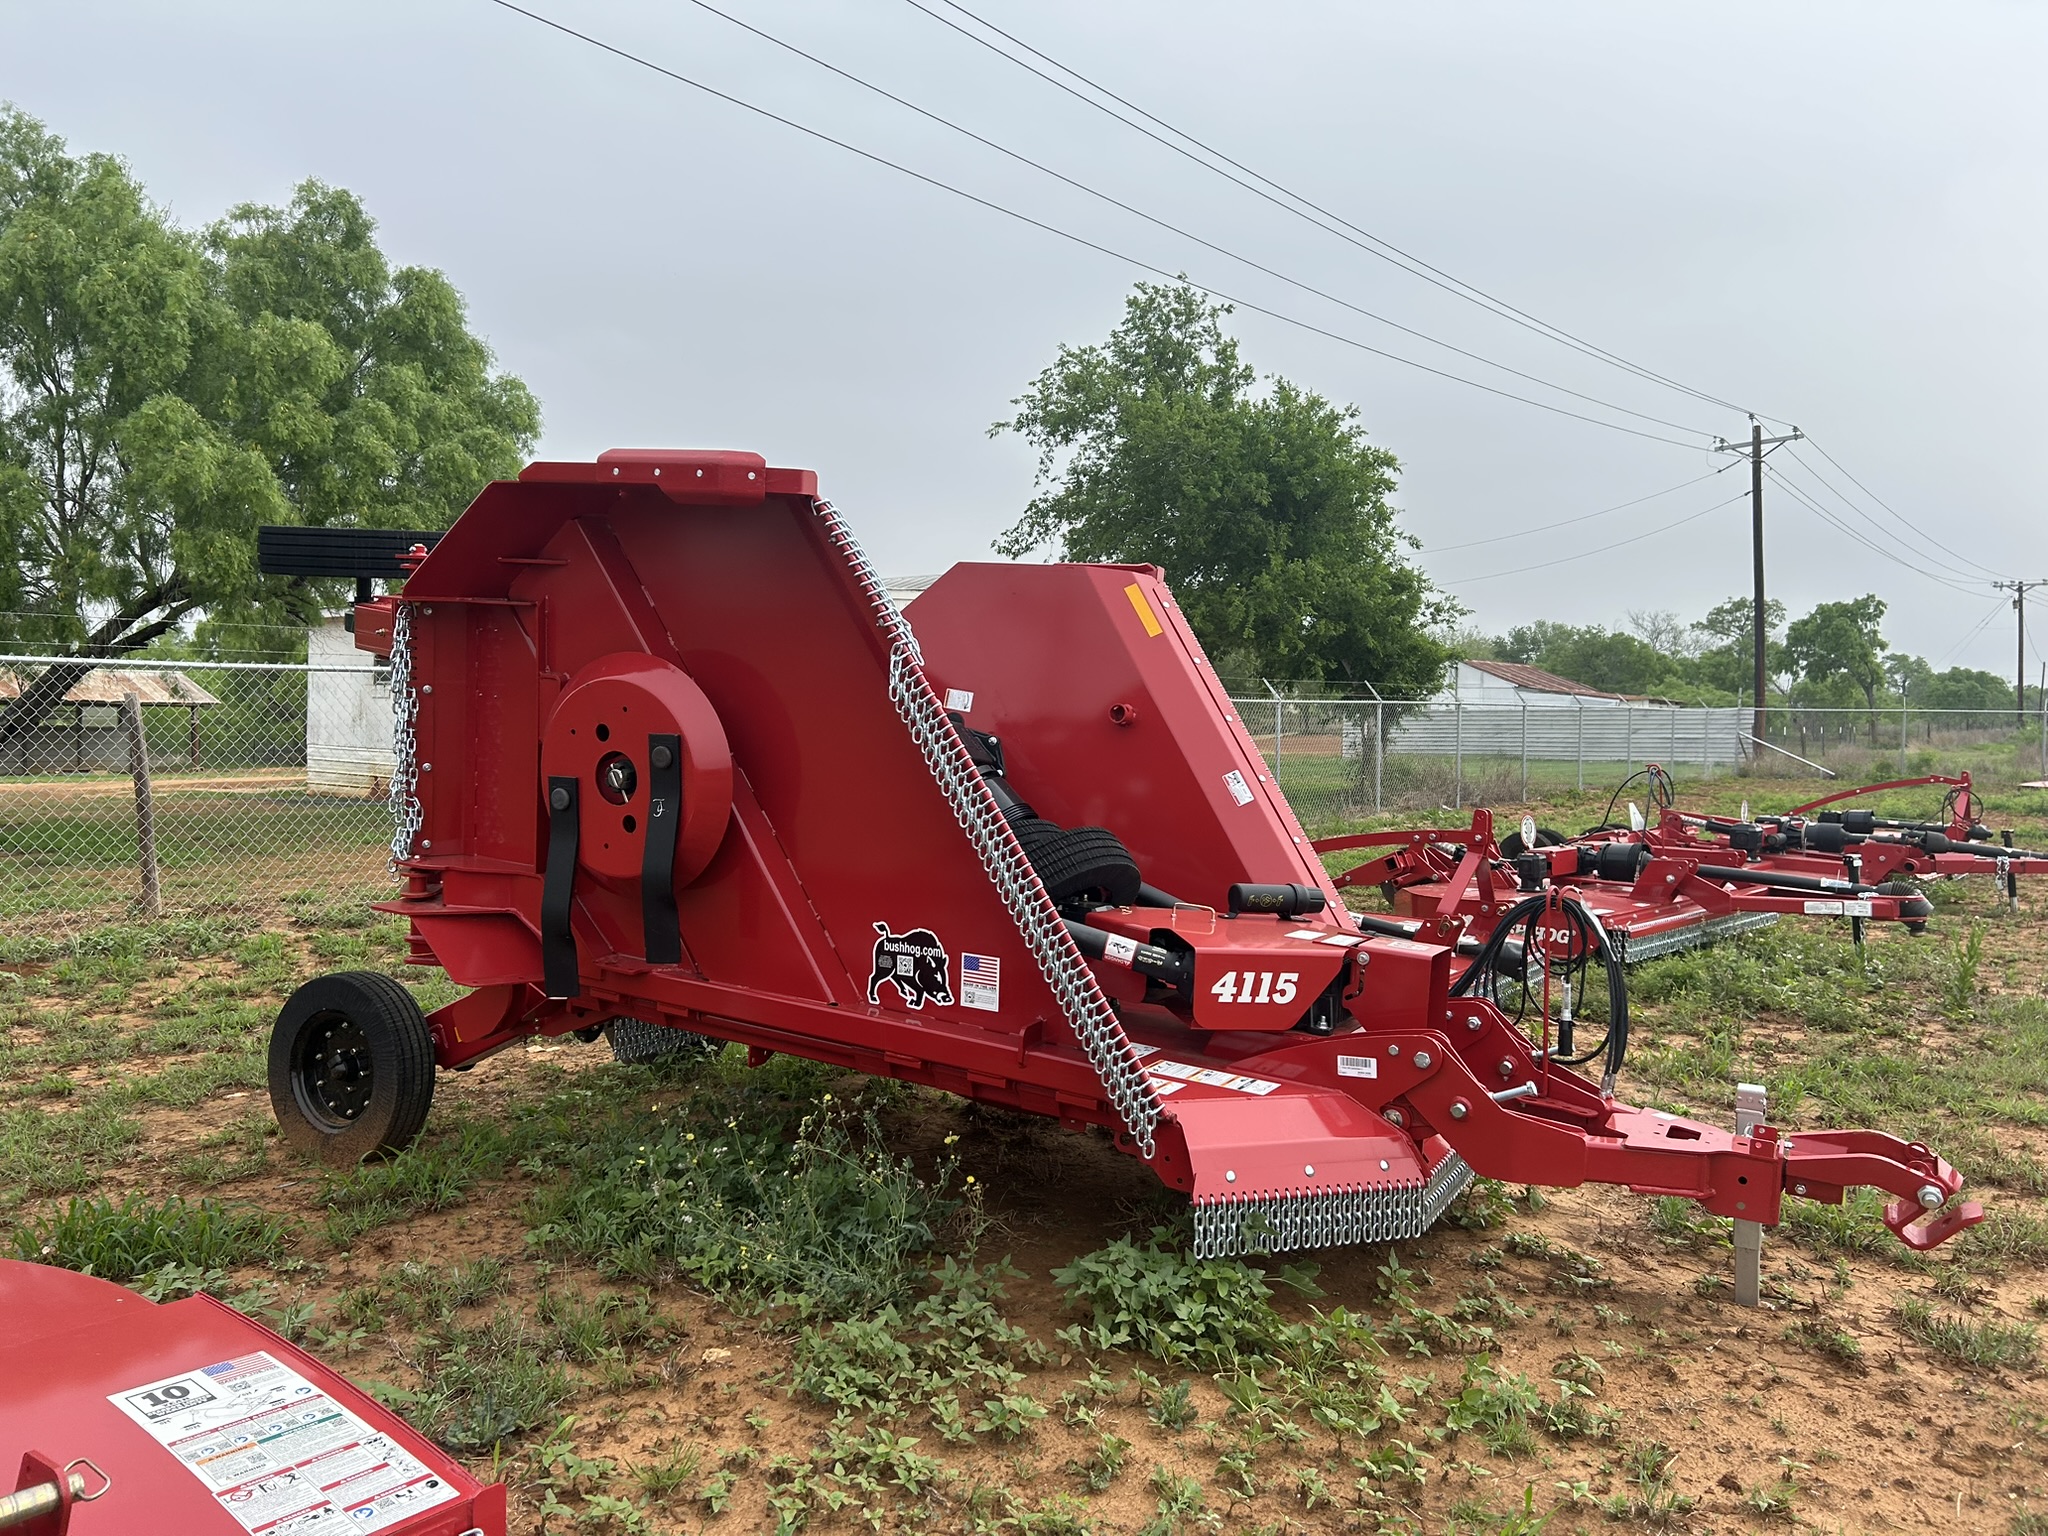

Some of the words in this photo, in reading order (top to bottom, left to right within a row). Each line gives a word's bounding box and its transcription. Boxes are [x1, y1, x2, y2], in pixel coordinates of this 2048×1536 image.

[884, 940, 941, 958] bushhog.com
[1210, 971, 1299, 1004] 4115
[217, 1377, 239, 1385] MADE
[142, 1385, 190, 1407] 10
[279, 1422, 318, 1436] IMPORTANT
[215, 1445, 248, 1458] WARNING
[318, 1449, 344, 1459] DANGER
[233, 1463, 266, 1477] WARNING
[345, 1469, 373, 1481] DANGER
[246, 1475, 275, 1486] DANGER
[380, 1485, 406, 1497] DANGER
[281, 1508, 311, 1521] DANGER
